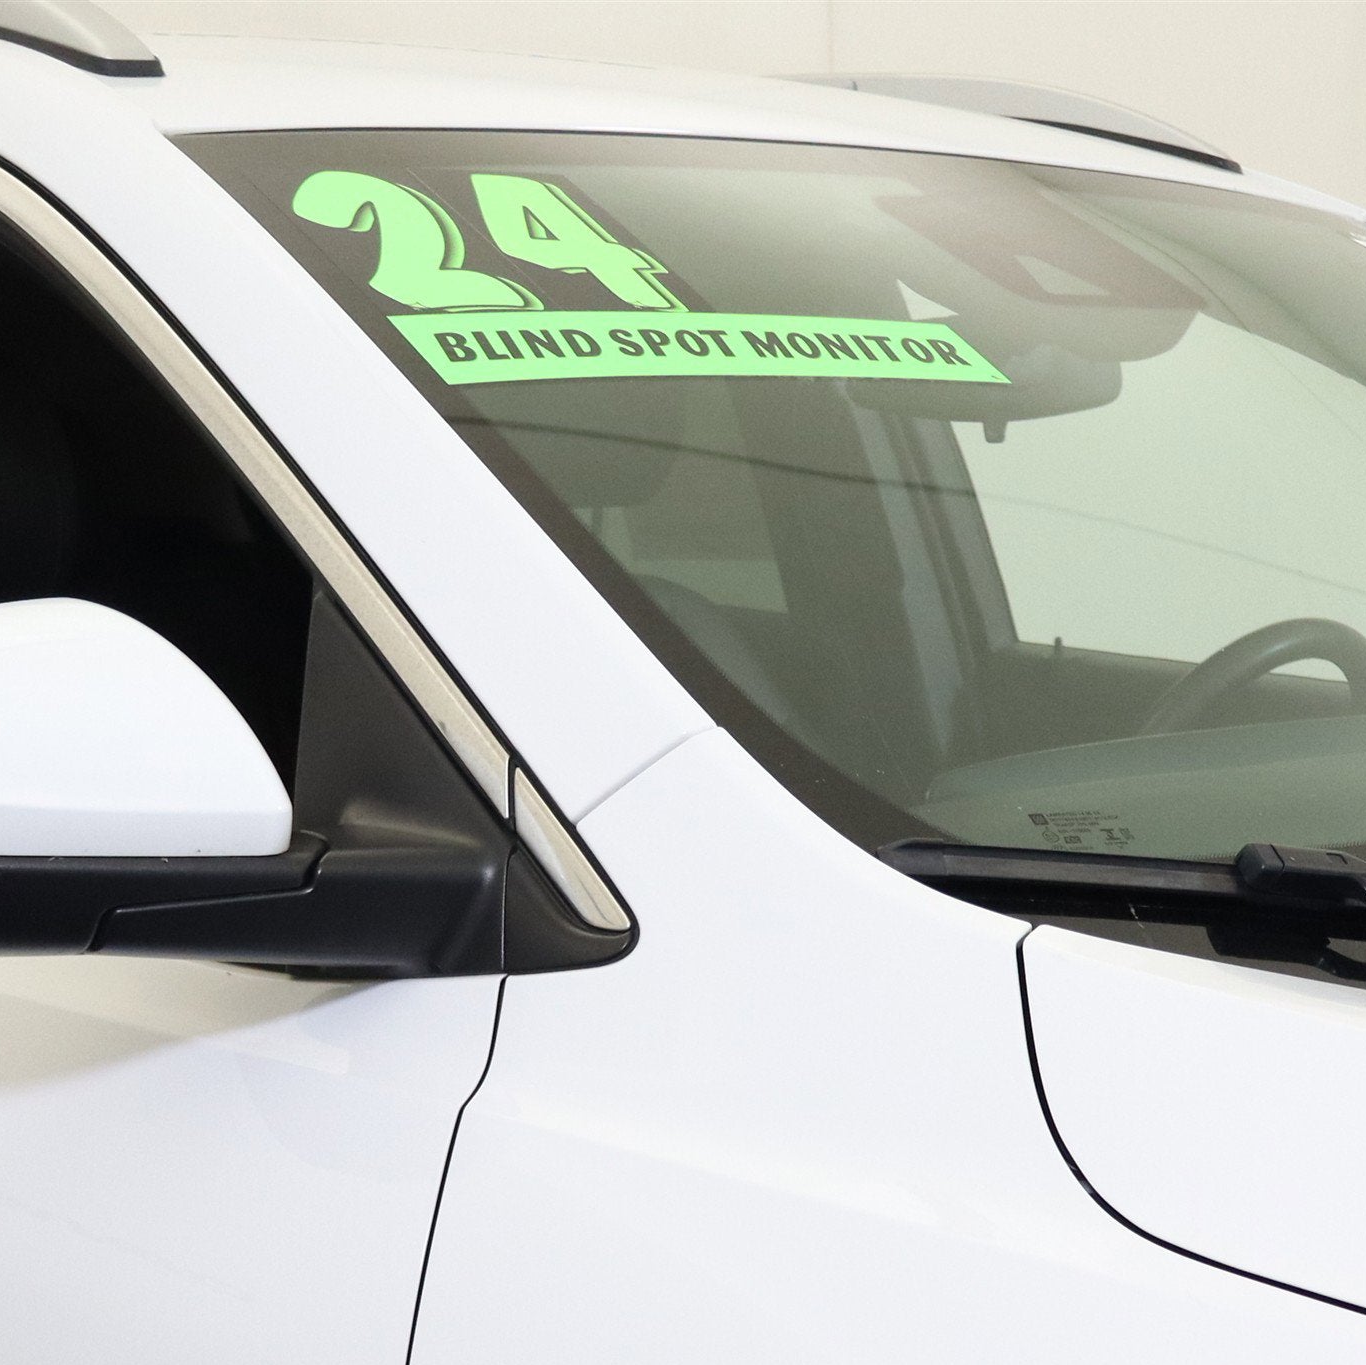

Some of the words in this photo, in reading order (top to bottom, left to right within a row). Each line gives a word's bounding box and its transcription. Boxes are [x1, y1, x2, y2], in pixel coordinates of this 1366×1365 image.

[292, 170, 689, 312] 24
[433, 328, 602, 363] BLIND
[608, 328, 736, 359] SPOT
[741, 330, 972, 367] MONITOR
